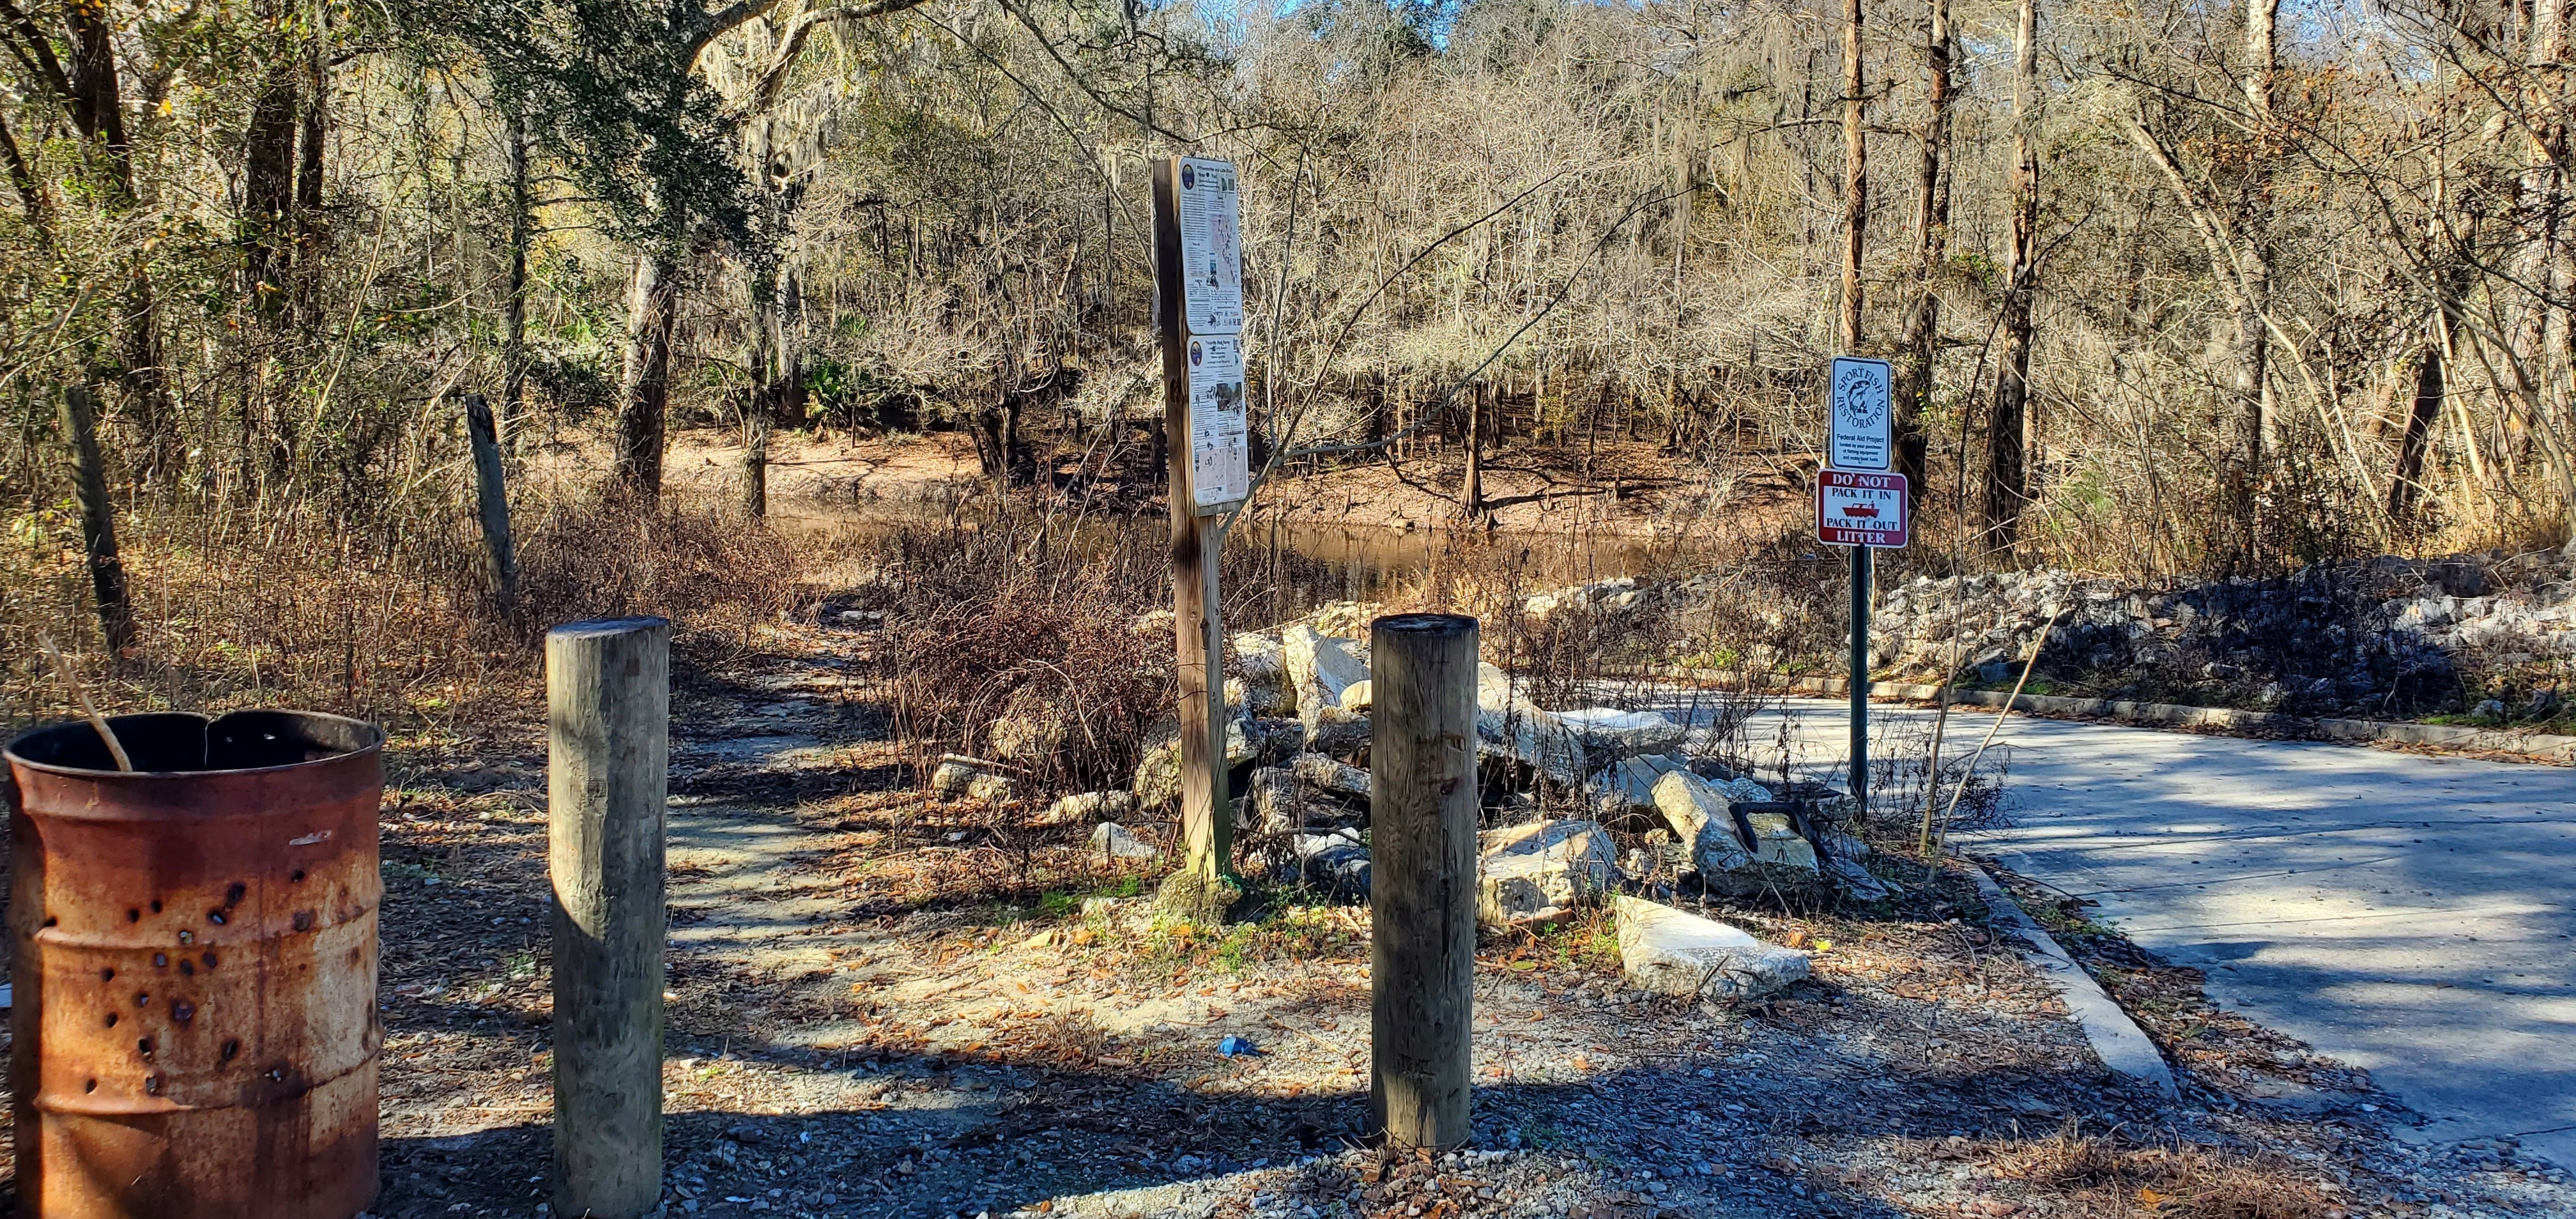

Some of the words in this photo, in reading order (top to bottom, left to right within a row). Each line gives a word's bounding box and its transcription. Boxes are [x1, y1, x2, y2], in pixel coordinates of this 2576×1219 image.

[1838, 367, 1864, 391] SPORT
[1864, 370, 1884, 394] FISH
[1837, 397, 1885, 428] RESTORATION
[1866, 436, 1884, 444] Project
[1833, 473, 1853, 486] DO
[1859, 476, 1890, 487] NOT
[1832, 487, 1857, 498] PACK
[1862, 489, 1873, 499] IT
[1879, 491, 1891, 500] IN
[1827, 518, 1851, 528] PACK
[1857, 520, 1866, 528] IT
[1873, 521, 1897, 530] OUT
[1837, 530, 1886, 543] LITTER
